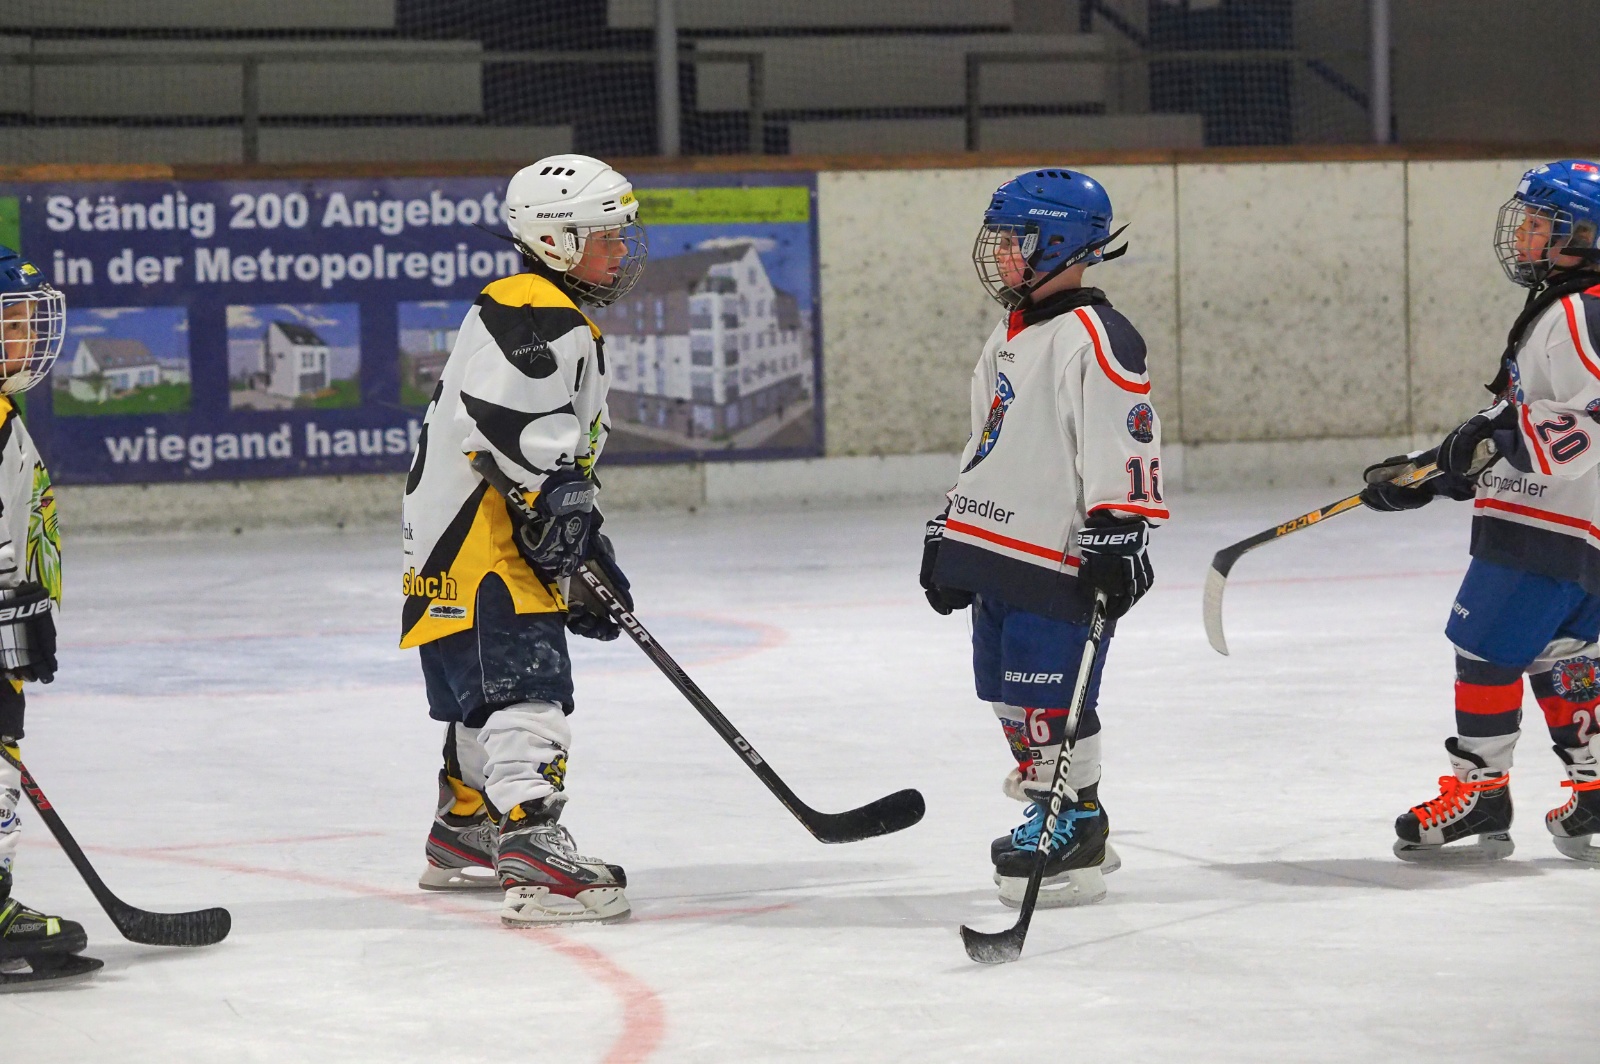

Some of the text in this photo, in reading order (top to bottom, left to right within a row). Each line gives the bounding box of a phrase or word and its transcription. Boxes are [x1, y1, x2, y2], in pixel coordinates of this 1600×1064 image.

[46, 191, 216, 239] Ständig
[229, 193, 309, 230] 200
[536, 211, 574, 219] BAUER
[1028, 208, 1069, 218] BAUER
[53, 249, 93, 285] in
[107, 249, 183, 285] der
[198, 243, 520, 289] Metropolregion
[105, 423, 293, 469] wiegand
[1533, 413, 1591, 465] 20
[403, 566, 458, 601] sloch
[577, 564, 653, 645] ECTOR
[1004, 670, 1064, 684] BAUER
[1037, 739, 1076, 856] Reebok
